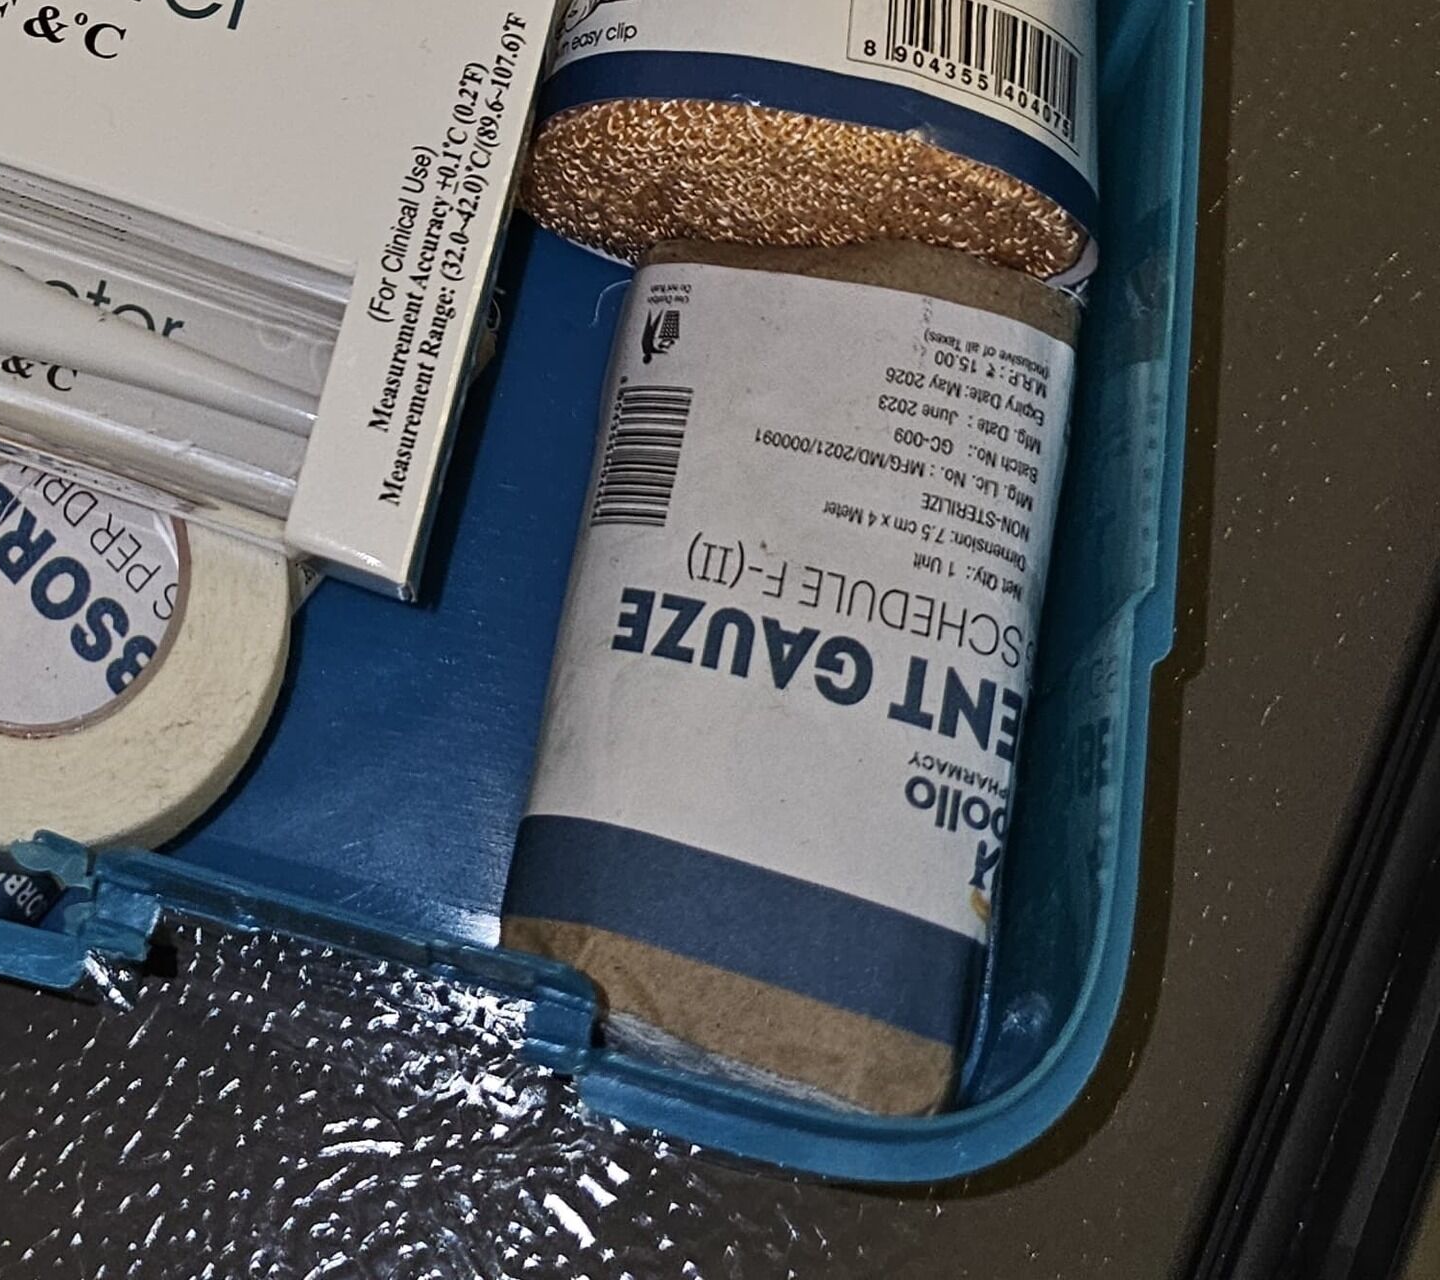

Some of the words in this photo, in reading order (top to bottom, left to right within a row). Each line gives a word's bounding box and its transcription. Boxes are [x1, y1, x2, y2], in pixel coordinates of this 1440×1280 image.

[606, 22, 637, 45] clip
[401, 145, 440, 194] Use)
[381, 196, 420, 275] Clinical
[366, 277, 398, 323] (For
[367, 291, 425, 433] Measurement
[409, 195, 455, 291] Accuracy
[378, 361, 435, 506] Measurement
[418, 285, 457, 359] Range:
[886, 367, 924, 388] 2026
[878, 394, 918, 416] 2023
[921, 405, 959, 426] June
[755, 428, 924, 477] MFG/MD/2021/000091
[894, 428, 954, 455] GC-009
[823, 500, 864, 525] Meter
[894, 518, 917, 534] cm
[921, 493, 1030, 541] NON-STERILIZE
[90, 513, 161, 593] PER
[913, 552, 941, 572] Unit
[797, 566, 1024, 668] SCHEDULE
[610, 586, 874, 707] GAUZE
